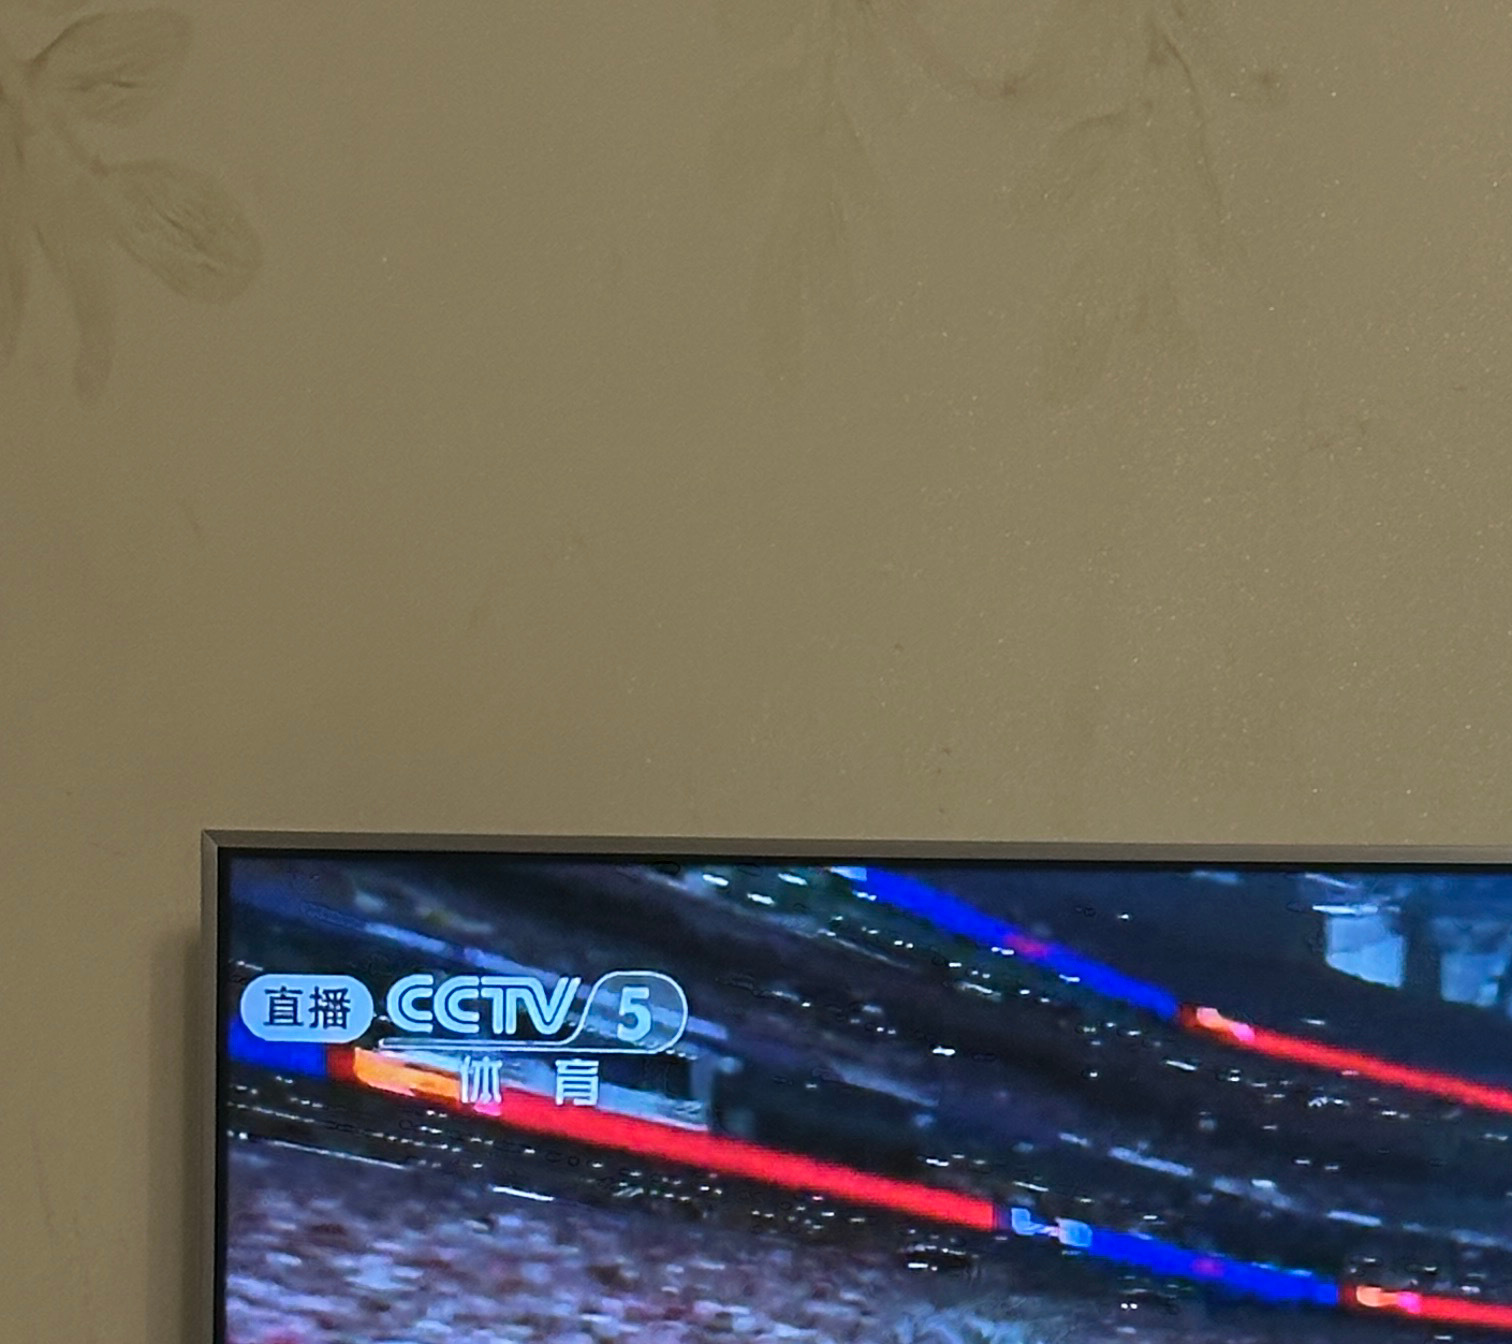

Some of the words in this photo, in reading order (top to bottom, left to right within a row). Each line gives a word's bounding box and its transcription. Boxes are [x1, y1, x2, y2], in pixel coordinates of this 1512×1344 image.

[264, 987, 351, 1030] 直播
[386, 975, 581, 1035] CCTV
[616, 986, 652, 1042] 5
[460, 1056, 599, 1107] 体育
